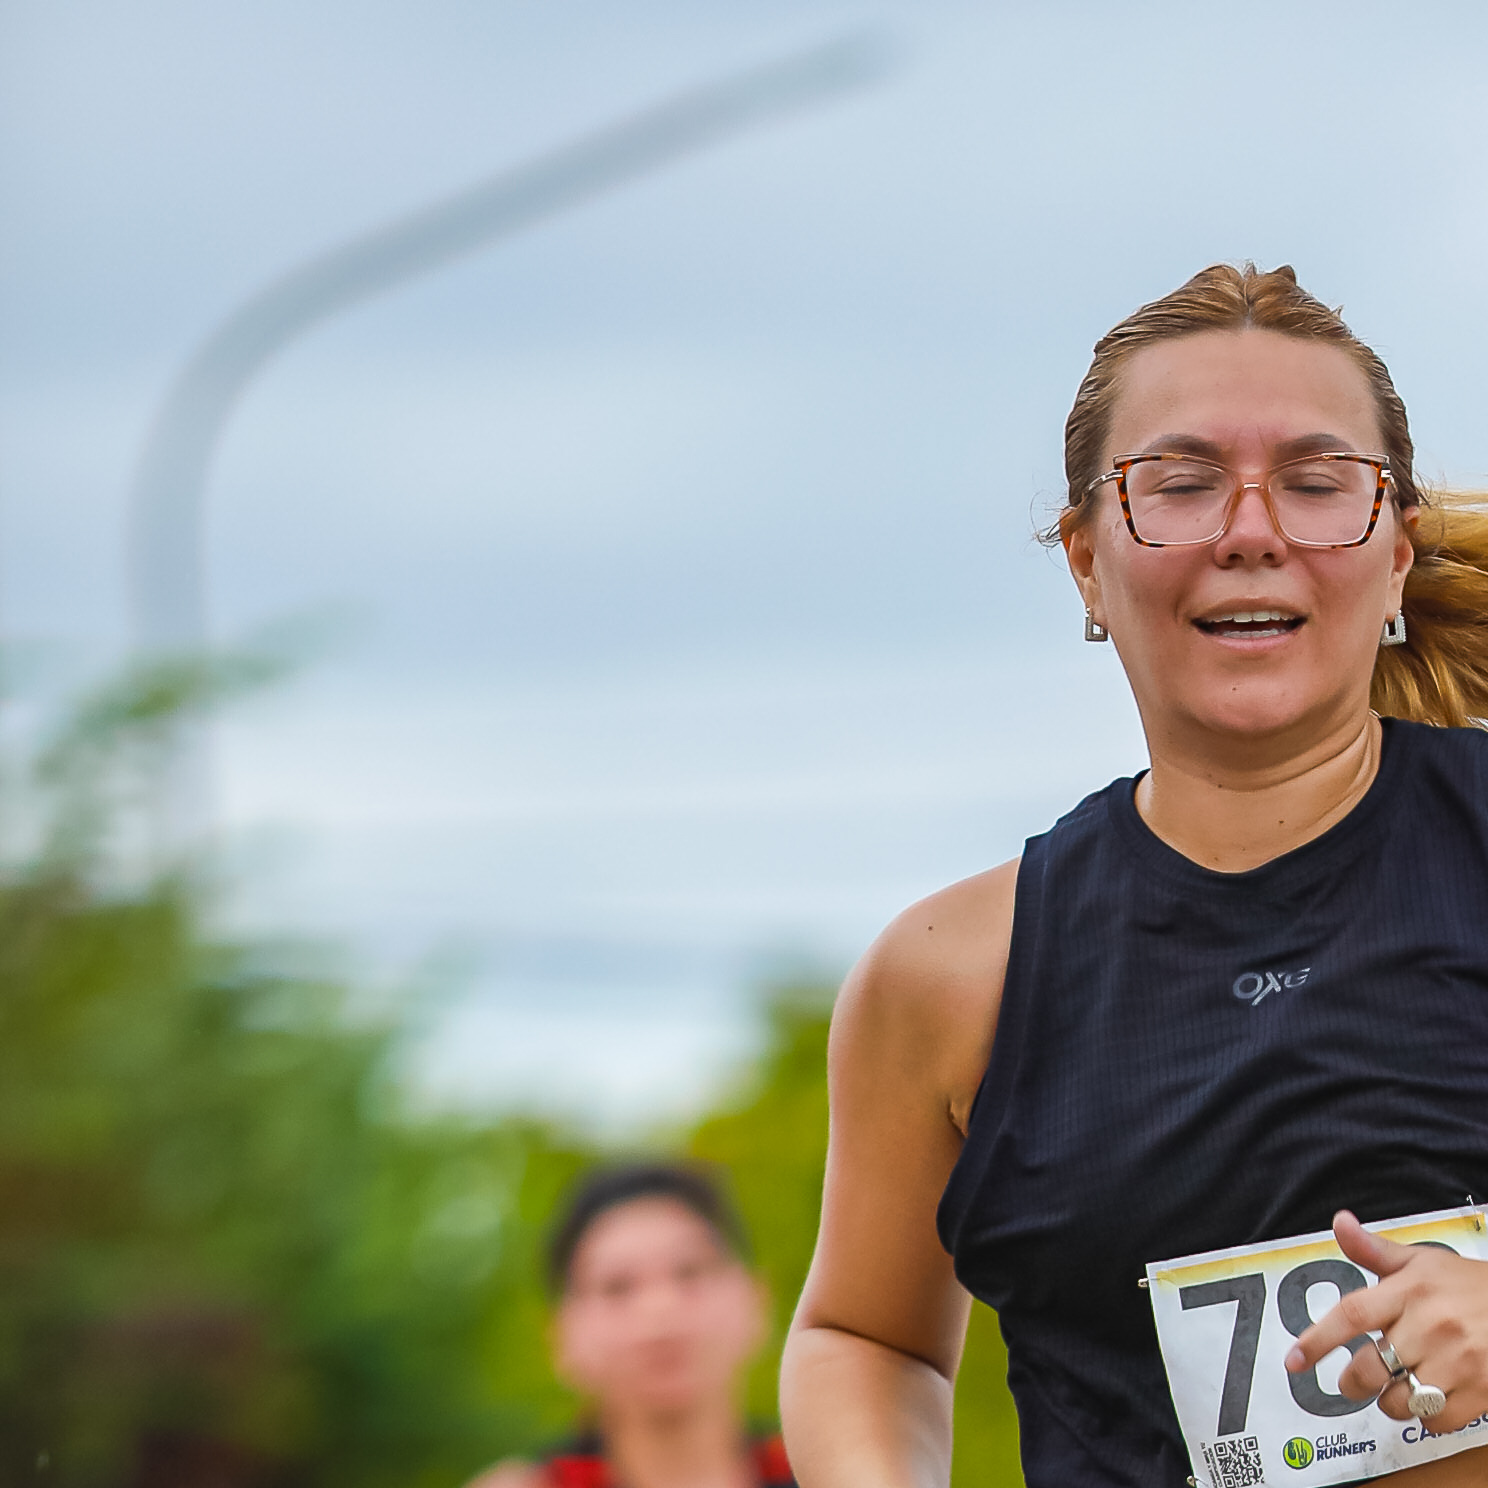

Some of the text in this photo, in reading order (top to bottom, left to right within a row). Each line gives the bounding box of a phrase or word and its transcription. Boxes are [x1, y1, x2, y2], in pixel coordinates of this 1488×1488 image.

[1180, 1241, 1462, 1437] 78
[1316, 1433, 1347, 1448] CLUB
[1317, 1440, 1377, 1461] RUNNER'S
